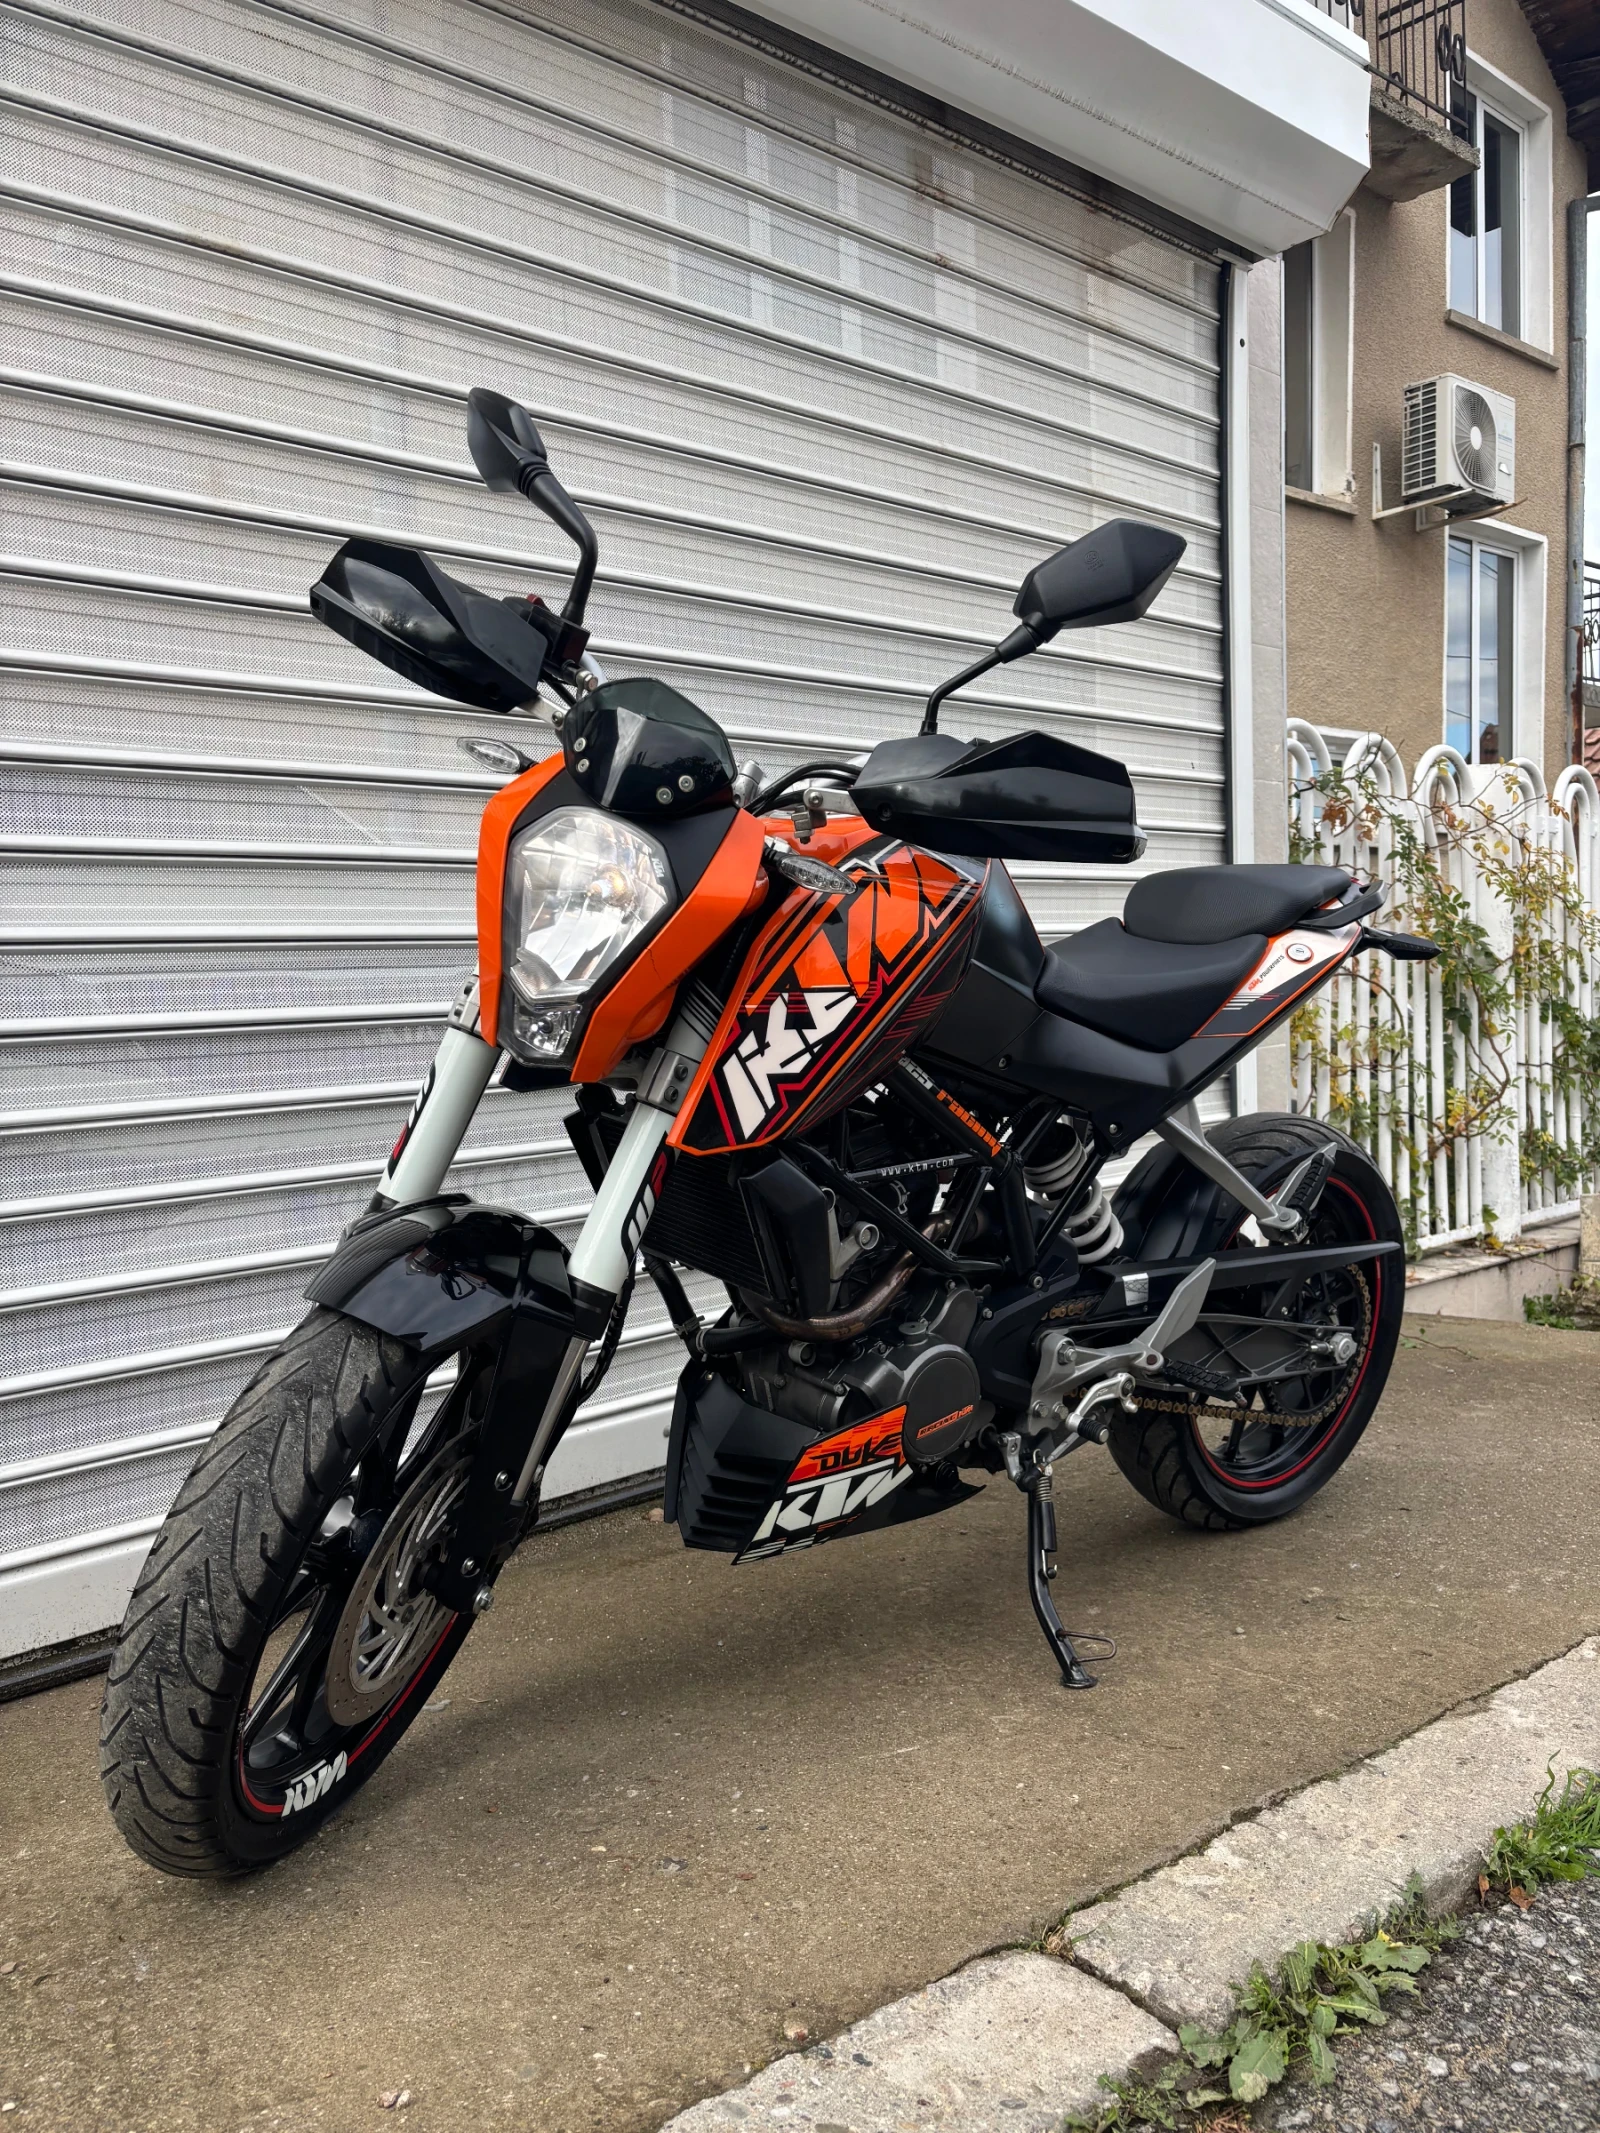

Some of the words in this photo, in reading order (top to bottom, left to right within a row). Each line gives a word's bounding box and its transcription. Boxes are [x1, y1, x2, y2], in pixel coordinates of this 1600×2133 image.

[880, 1157, 955, 1177] www.ktm.com
[808, 1431, 902, 1471] DUKE
[751, 1457, 914, 1542] KTM
[281, 1750, 347, 1818] KTM
